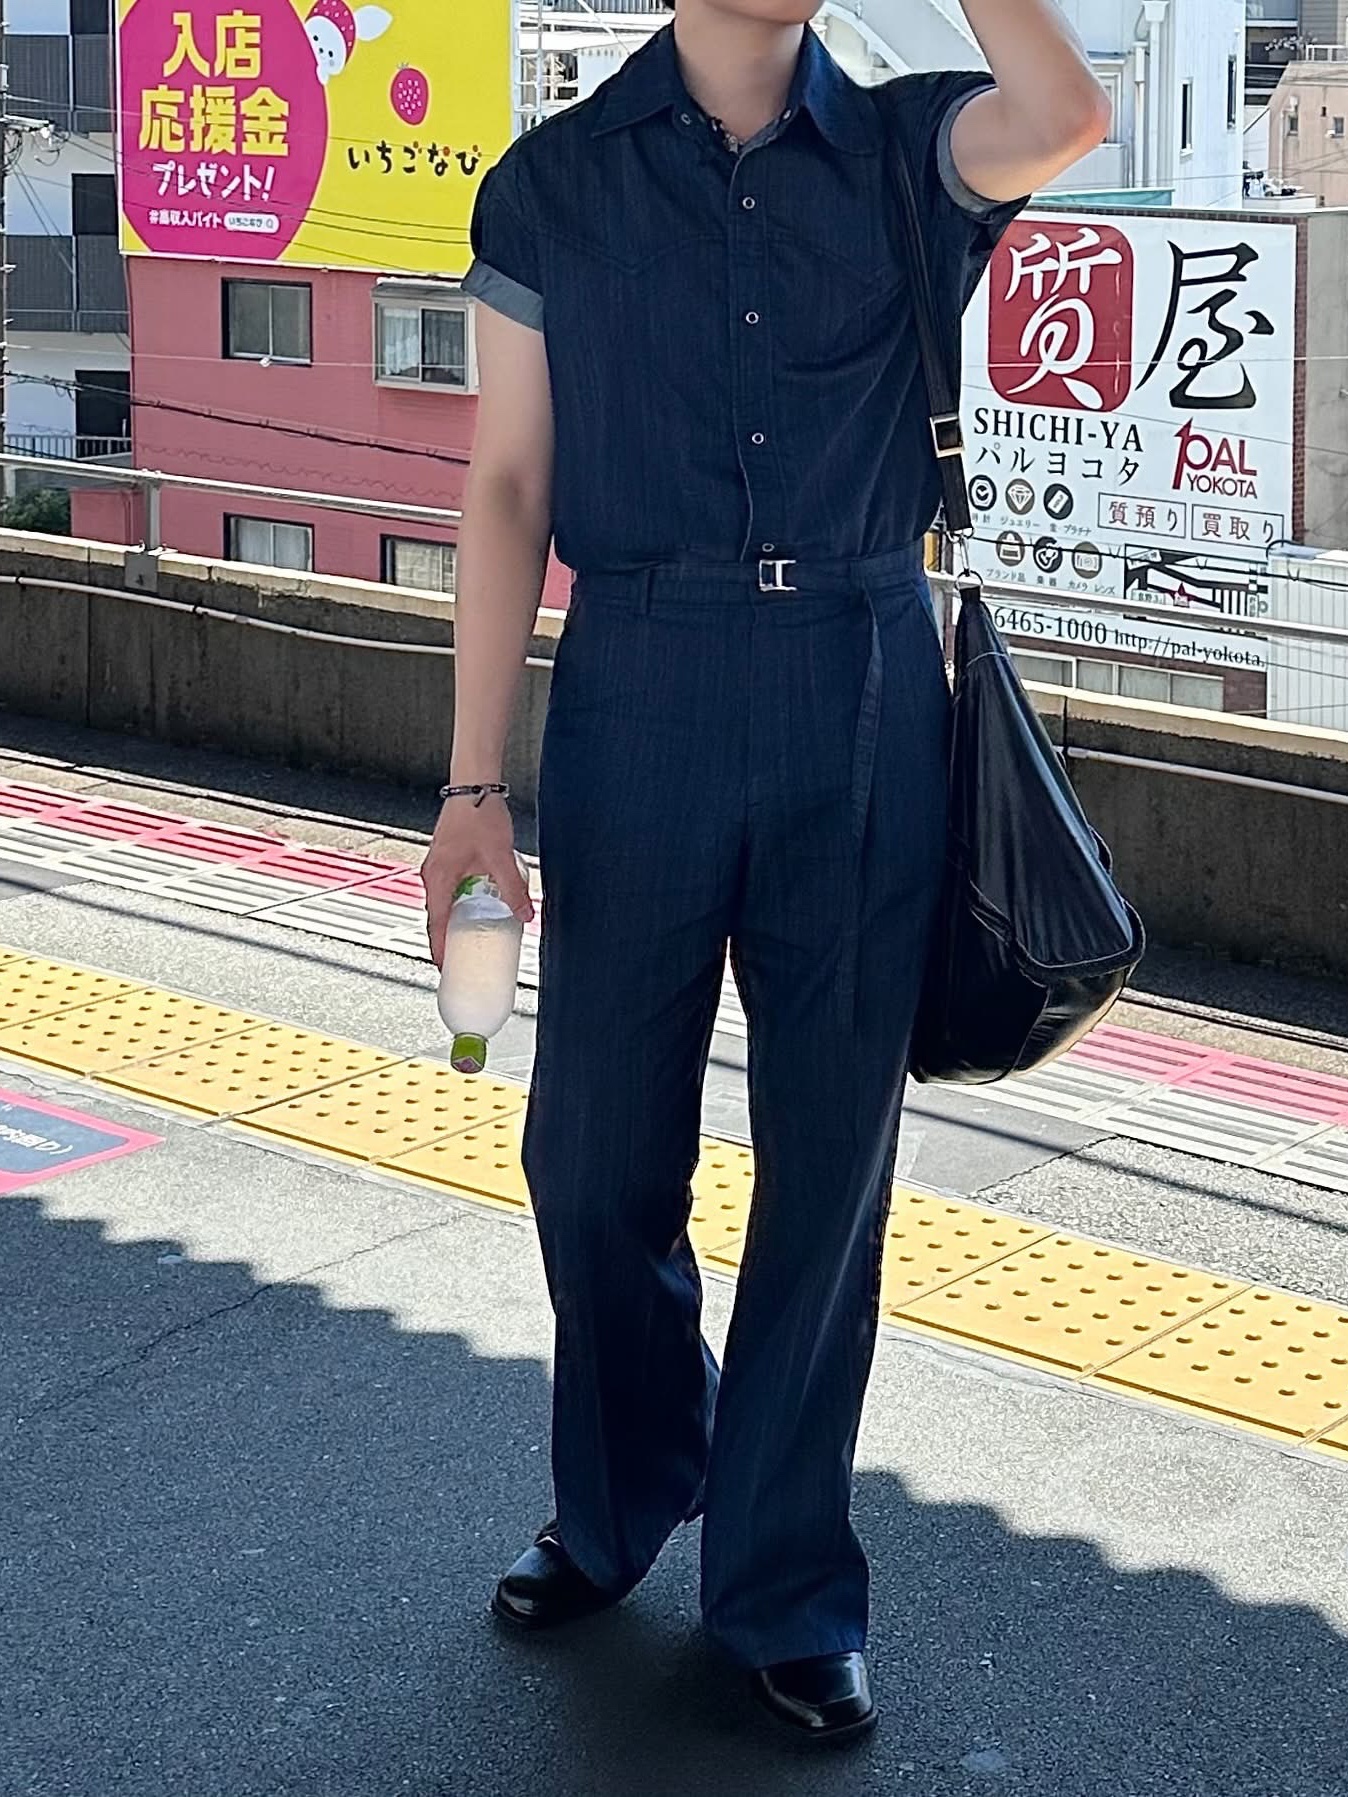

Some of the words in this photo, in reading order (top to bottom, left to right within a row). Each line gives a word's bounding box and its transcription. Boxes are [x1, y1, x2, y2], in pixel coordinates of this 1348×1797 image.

[163, 10, 262, 80] 入店
[138, 83, 290, 156] 応援金
[348, 139, 483, 177] いちごなび
[973, 408, 1144, 453] SHICHI-YA
[975, 442, 1141, 485] パルヨコタ
[1187, 473, 1258, 500] YOKOTA
[1109, 501, 1178, 532] 質預り
[1202, 512, 1274, 544] 買取り
[994, 606, 1107, 644] 6465-1000
